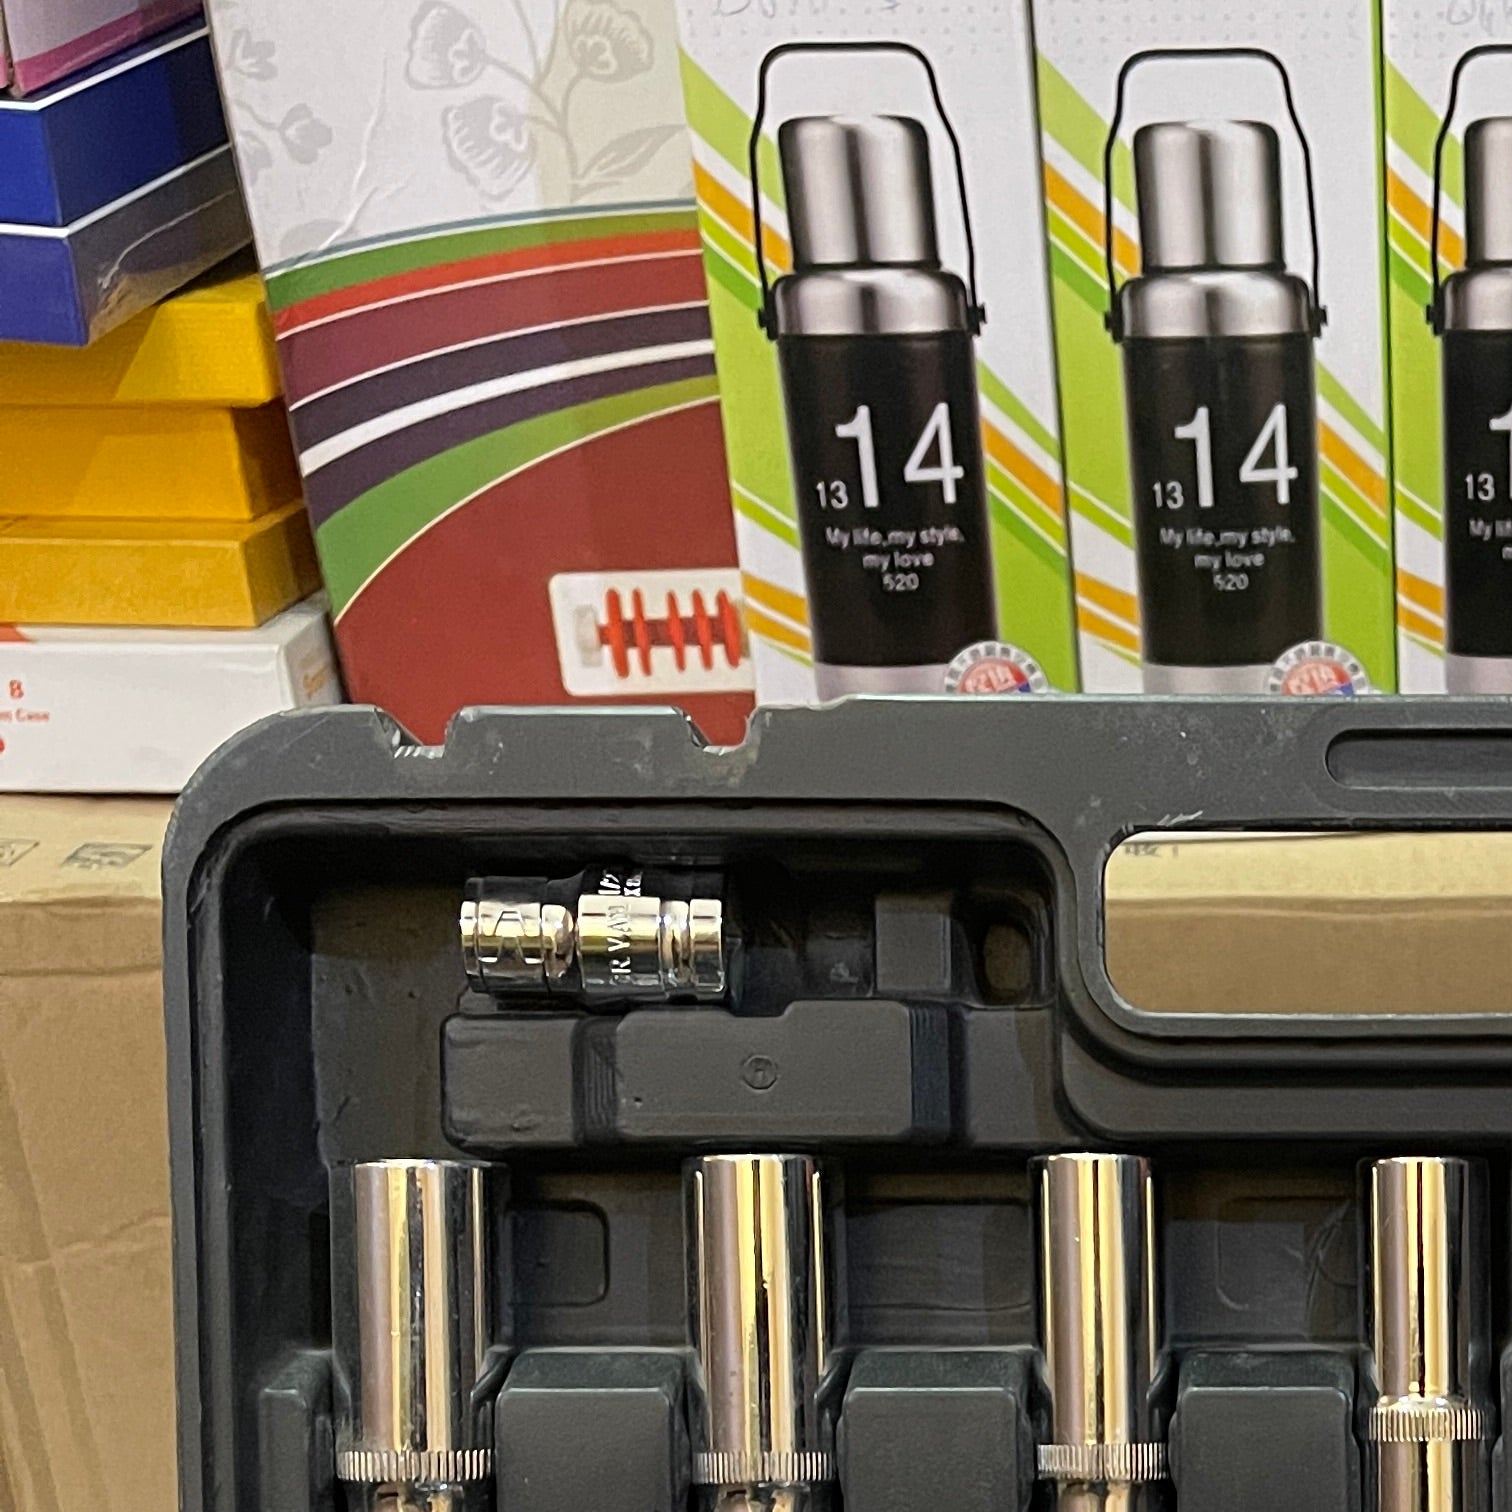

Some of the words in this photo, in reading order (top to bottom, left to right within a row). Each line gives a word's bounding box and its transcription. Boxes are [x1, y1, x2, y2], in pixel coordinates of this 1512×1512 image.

[835, 402, 964, 508] 14
[1174, 403, 1298, 508] 14
[816, 479, 848, 509] 13
[1152, 480, 1184, 509] 13
[1465, 473, 1495, 501] 13
[863, 553, 890, 572] my
[893, 551, 934, 568] love
[1194, 554, 1222, 571] my
[1225, 551, 1264, 568] love
[882, 572, 919, 591] 520
[1213, 573, 1249, 591] 520
